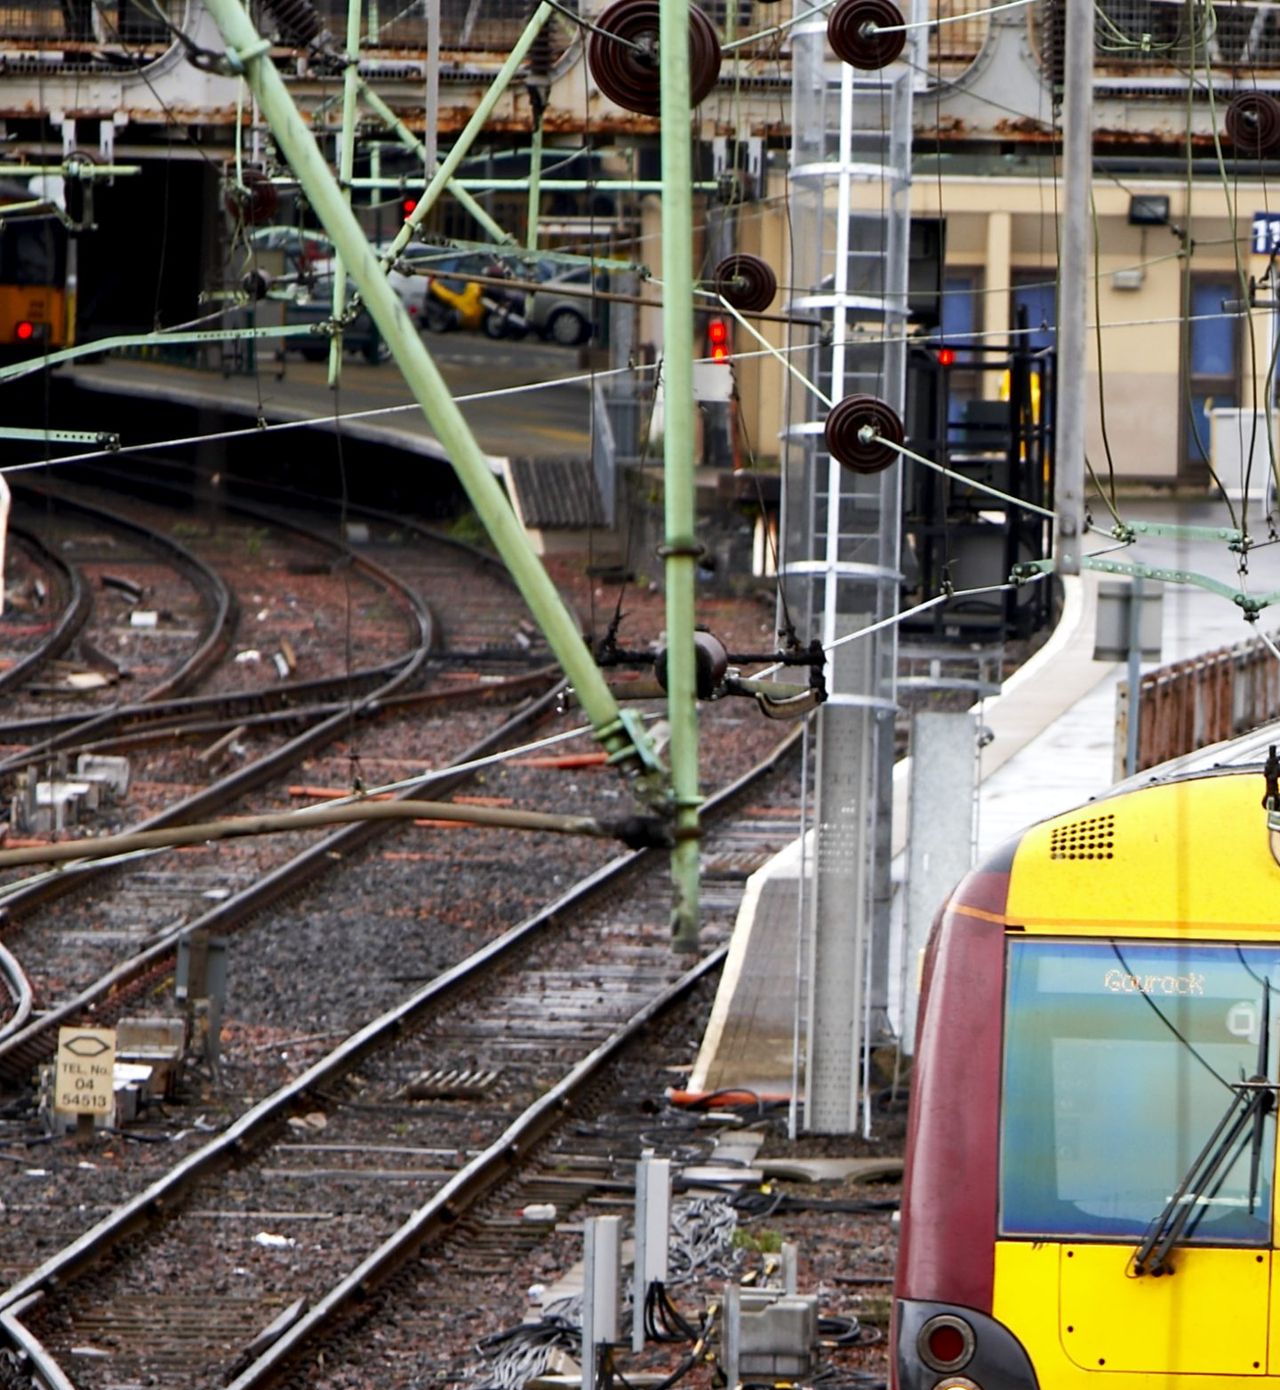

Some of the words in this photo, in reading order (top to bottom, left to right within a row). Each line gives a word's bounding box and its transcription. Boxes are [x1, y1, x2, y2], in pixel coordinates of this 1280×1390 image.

[1104, 969, 1205, 995] Gourock
[75, 1078, 94, 1091] 04
[62, 1093, 107, 1107] 54513
